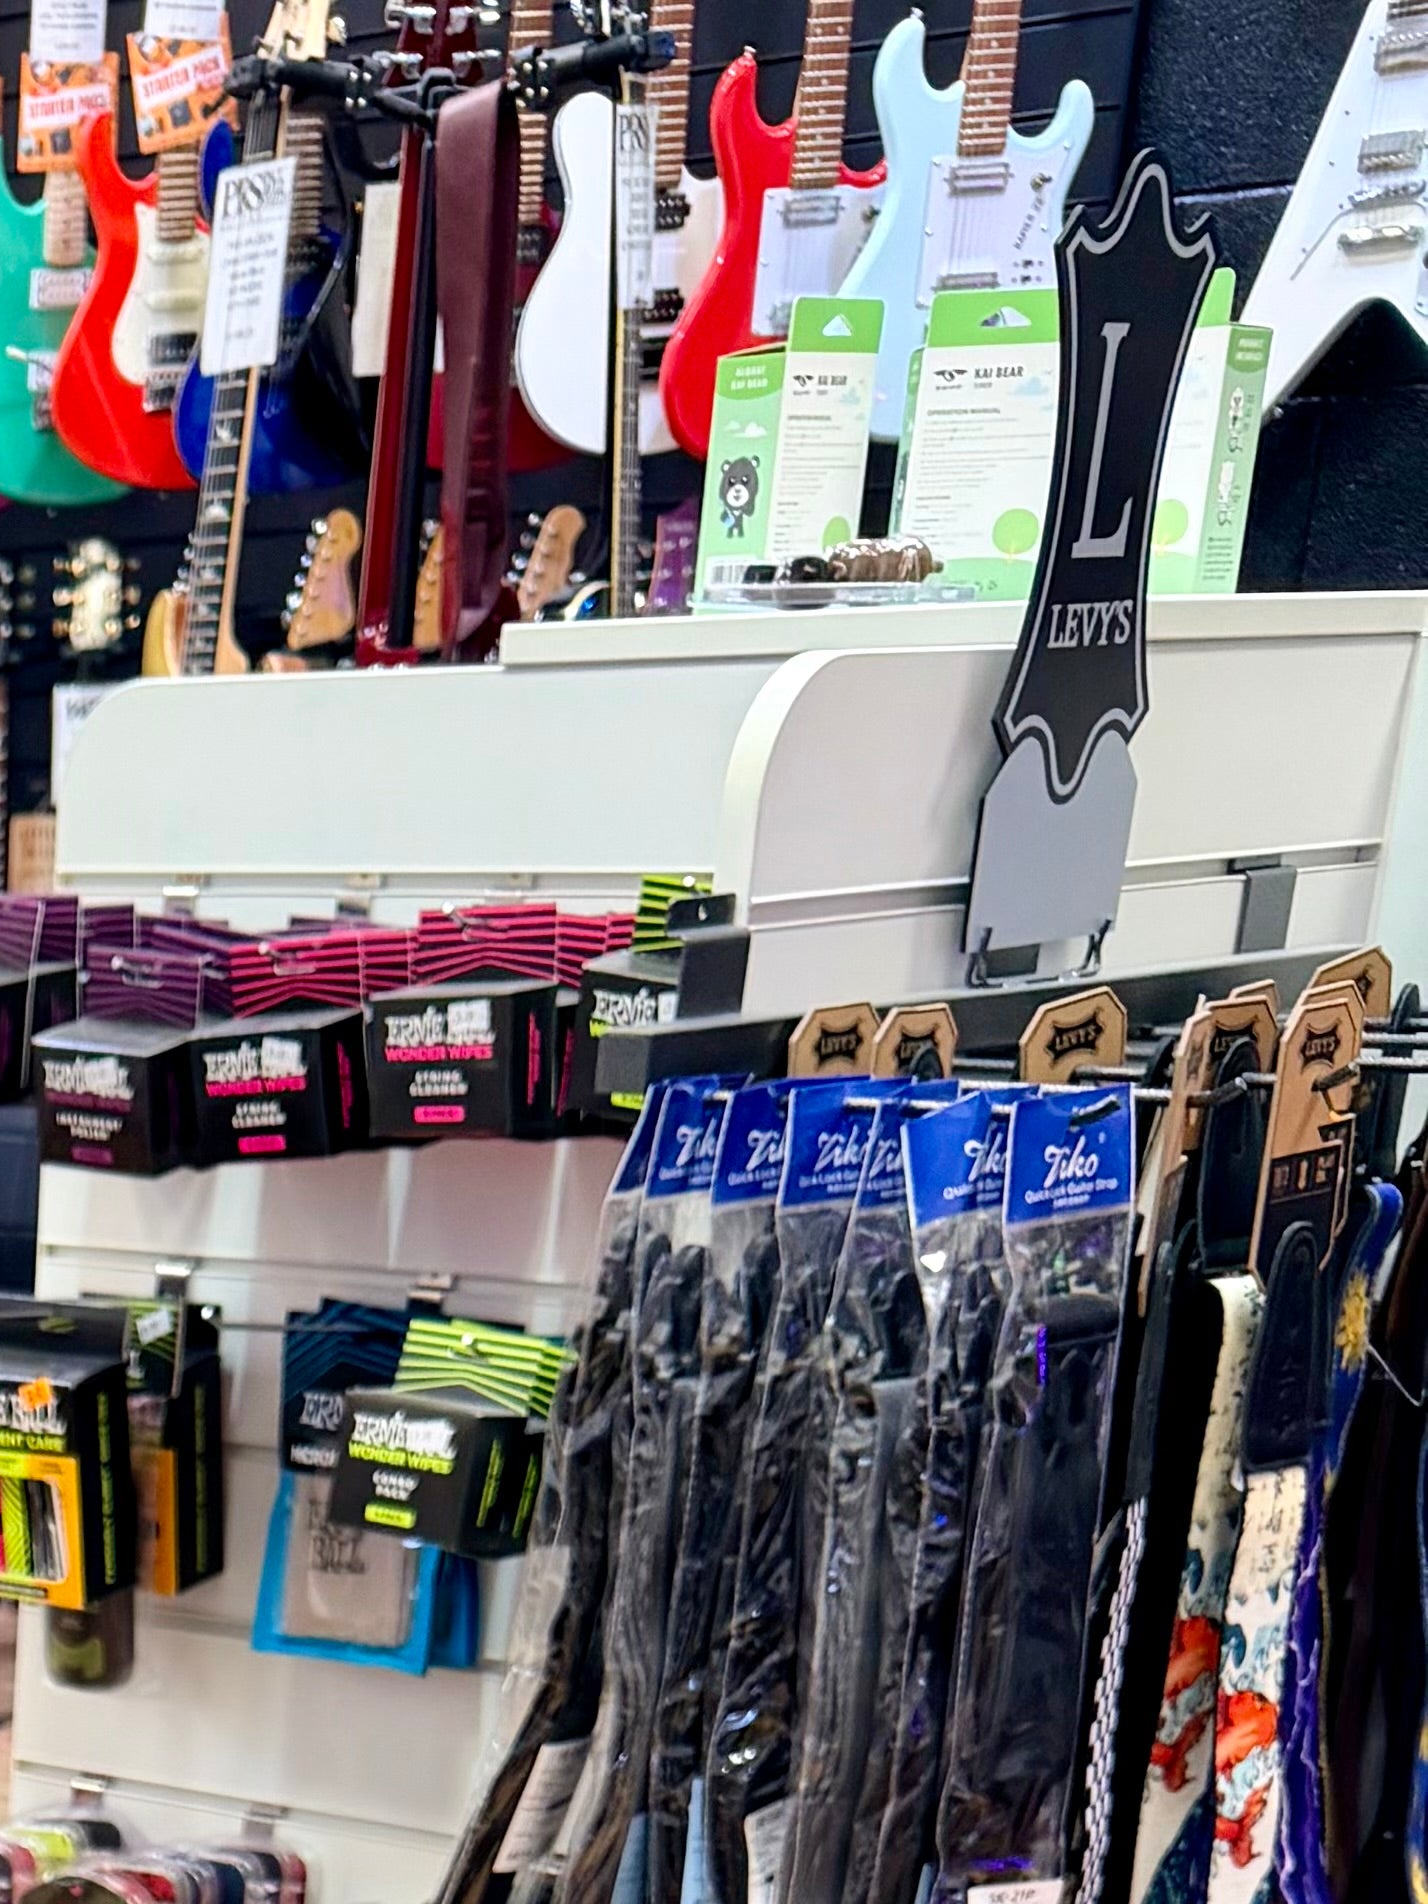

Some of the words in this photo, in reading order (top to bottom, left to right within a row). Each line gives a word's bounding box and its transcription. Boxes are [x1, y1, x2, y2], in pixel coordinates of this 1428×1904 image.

[1071, 321, 1134, 559] L
[384, 1005, 443, 1048] ERNIE
[593, 986, 658, 1027] ERNIE
[1044, 1135, 1099, 1189] Tiko
[300, 1391, 343, 1431] ERN
